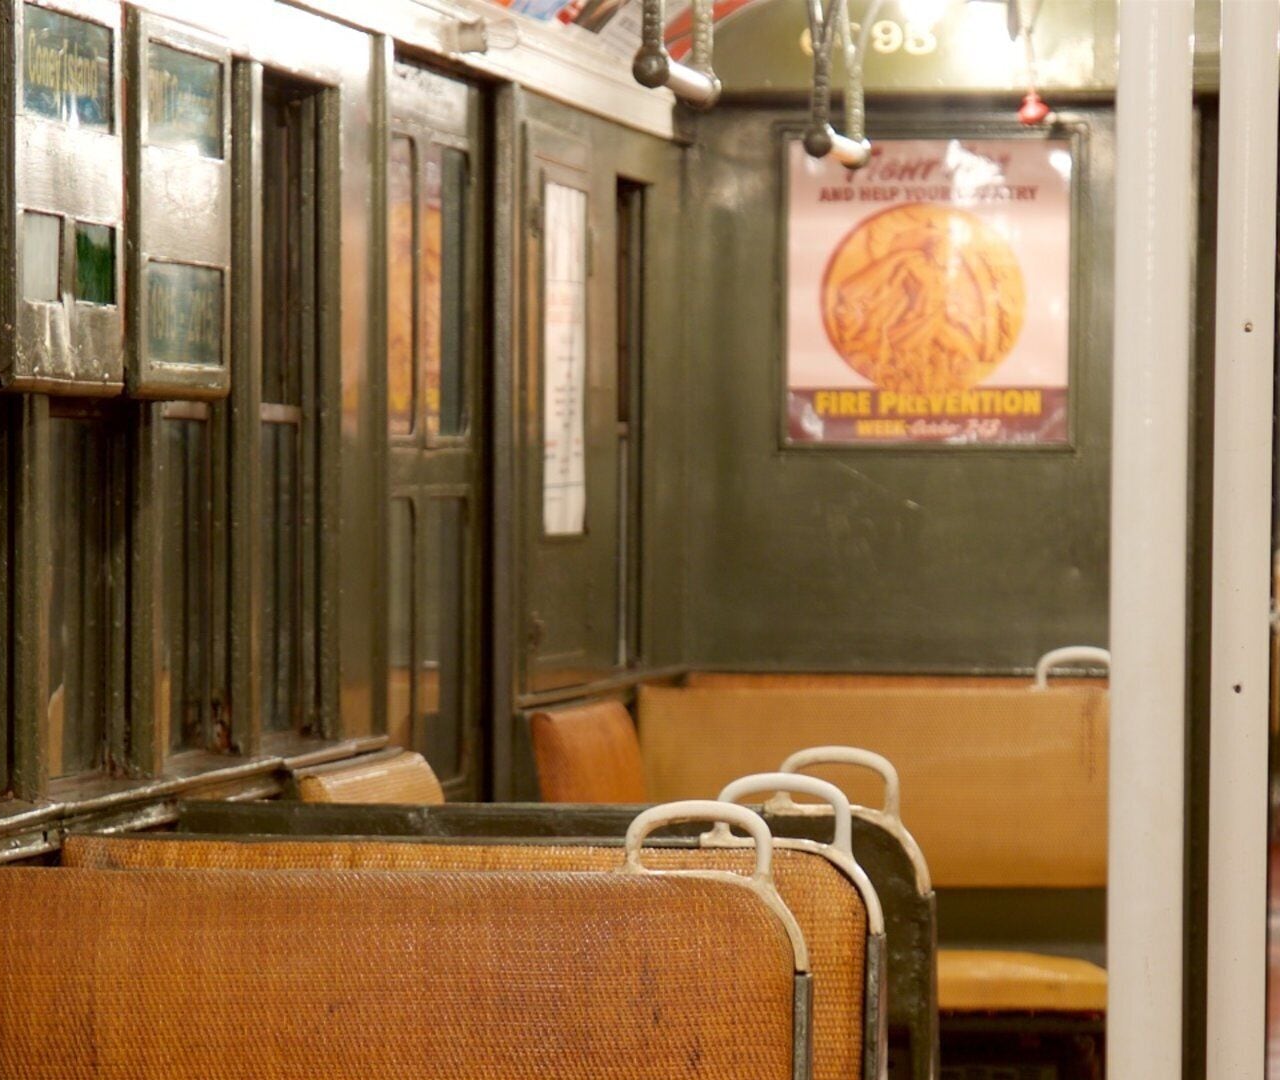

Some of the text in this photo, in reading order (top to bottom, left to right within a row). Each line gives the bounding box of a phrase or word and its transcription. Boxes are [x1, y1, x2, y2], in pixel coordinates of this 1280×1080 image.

[819, 186, 855, 202] AND
[859, 186, 900, 202] HELP
[904, 186, 952, 202] YOUR
[814, 388, 1043, 417] FIRE PREVENTION
